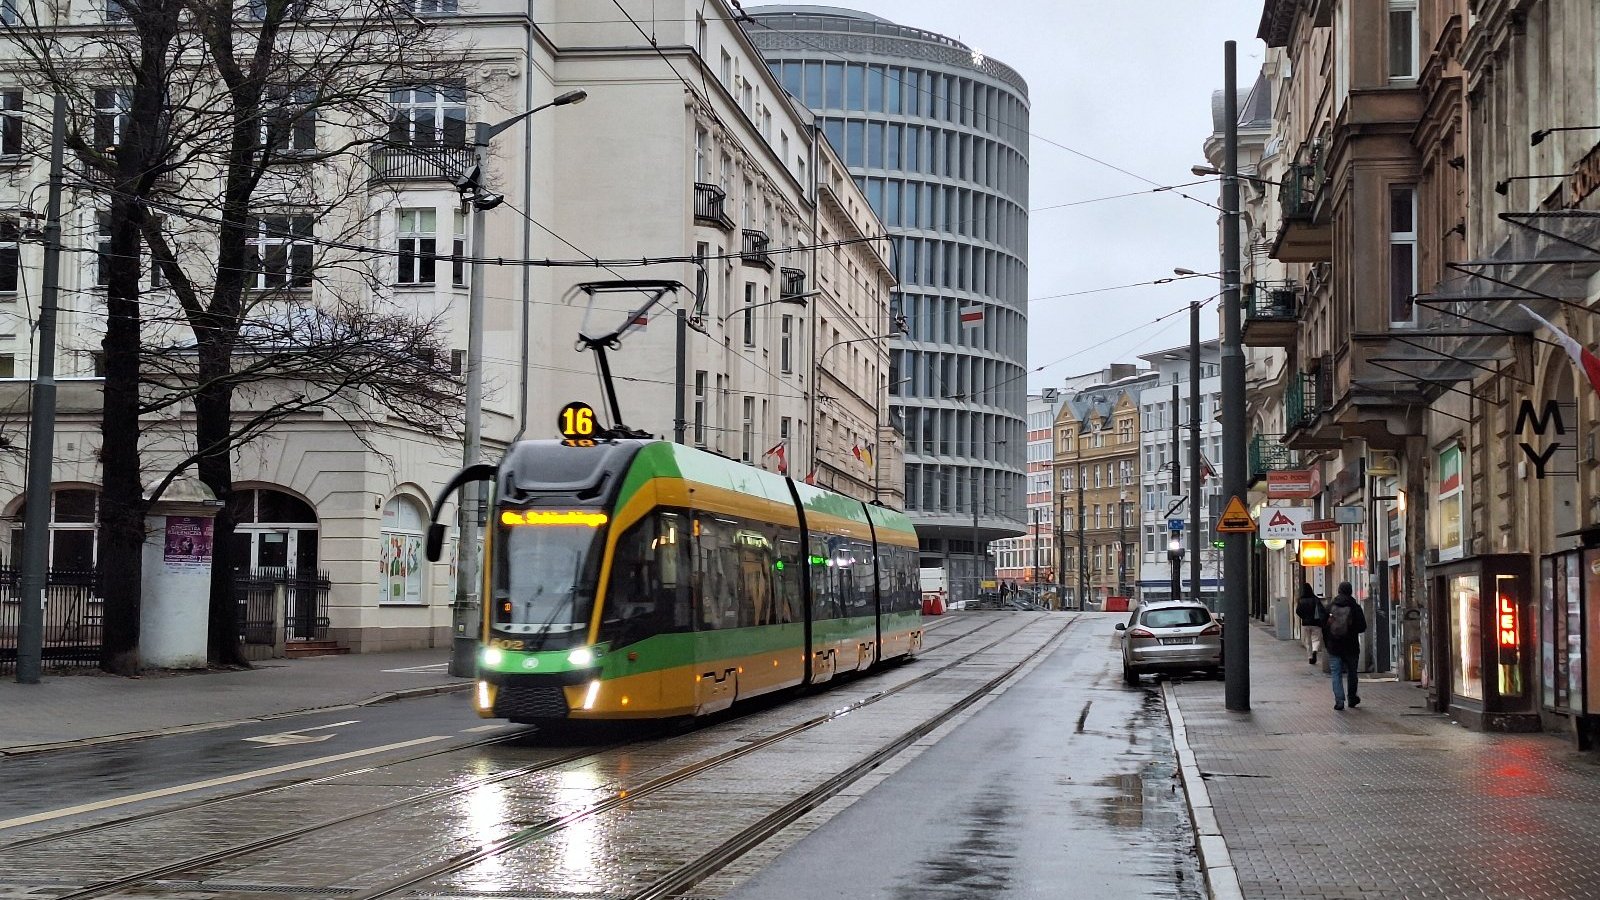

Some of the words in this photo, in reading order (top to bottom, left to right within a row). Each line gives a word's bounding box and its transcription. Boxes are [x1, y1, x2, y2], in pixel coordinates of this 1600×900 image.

[563, 407, 593, 435] 16
[1514, 399, 1566, 480] MY
[1501, 598, 1515, 645] LEN
